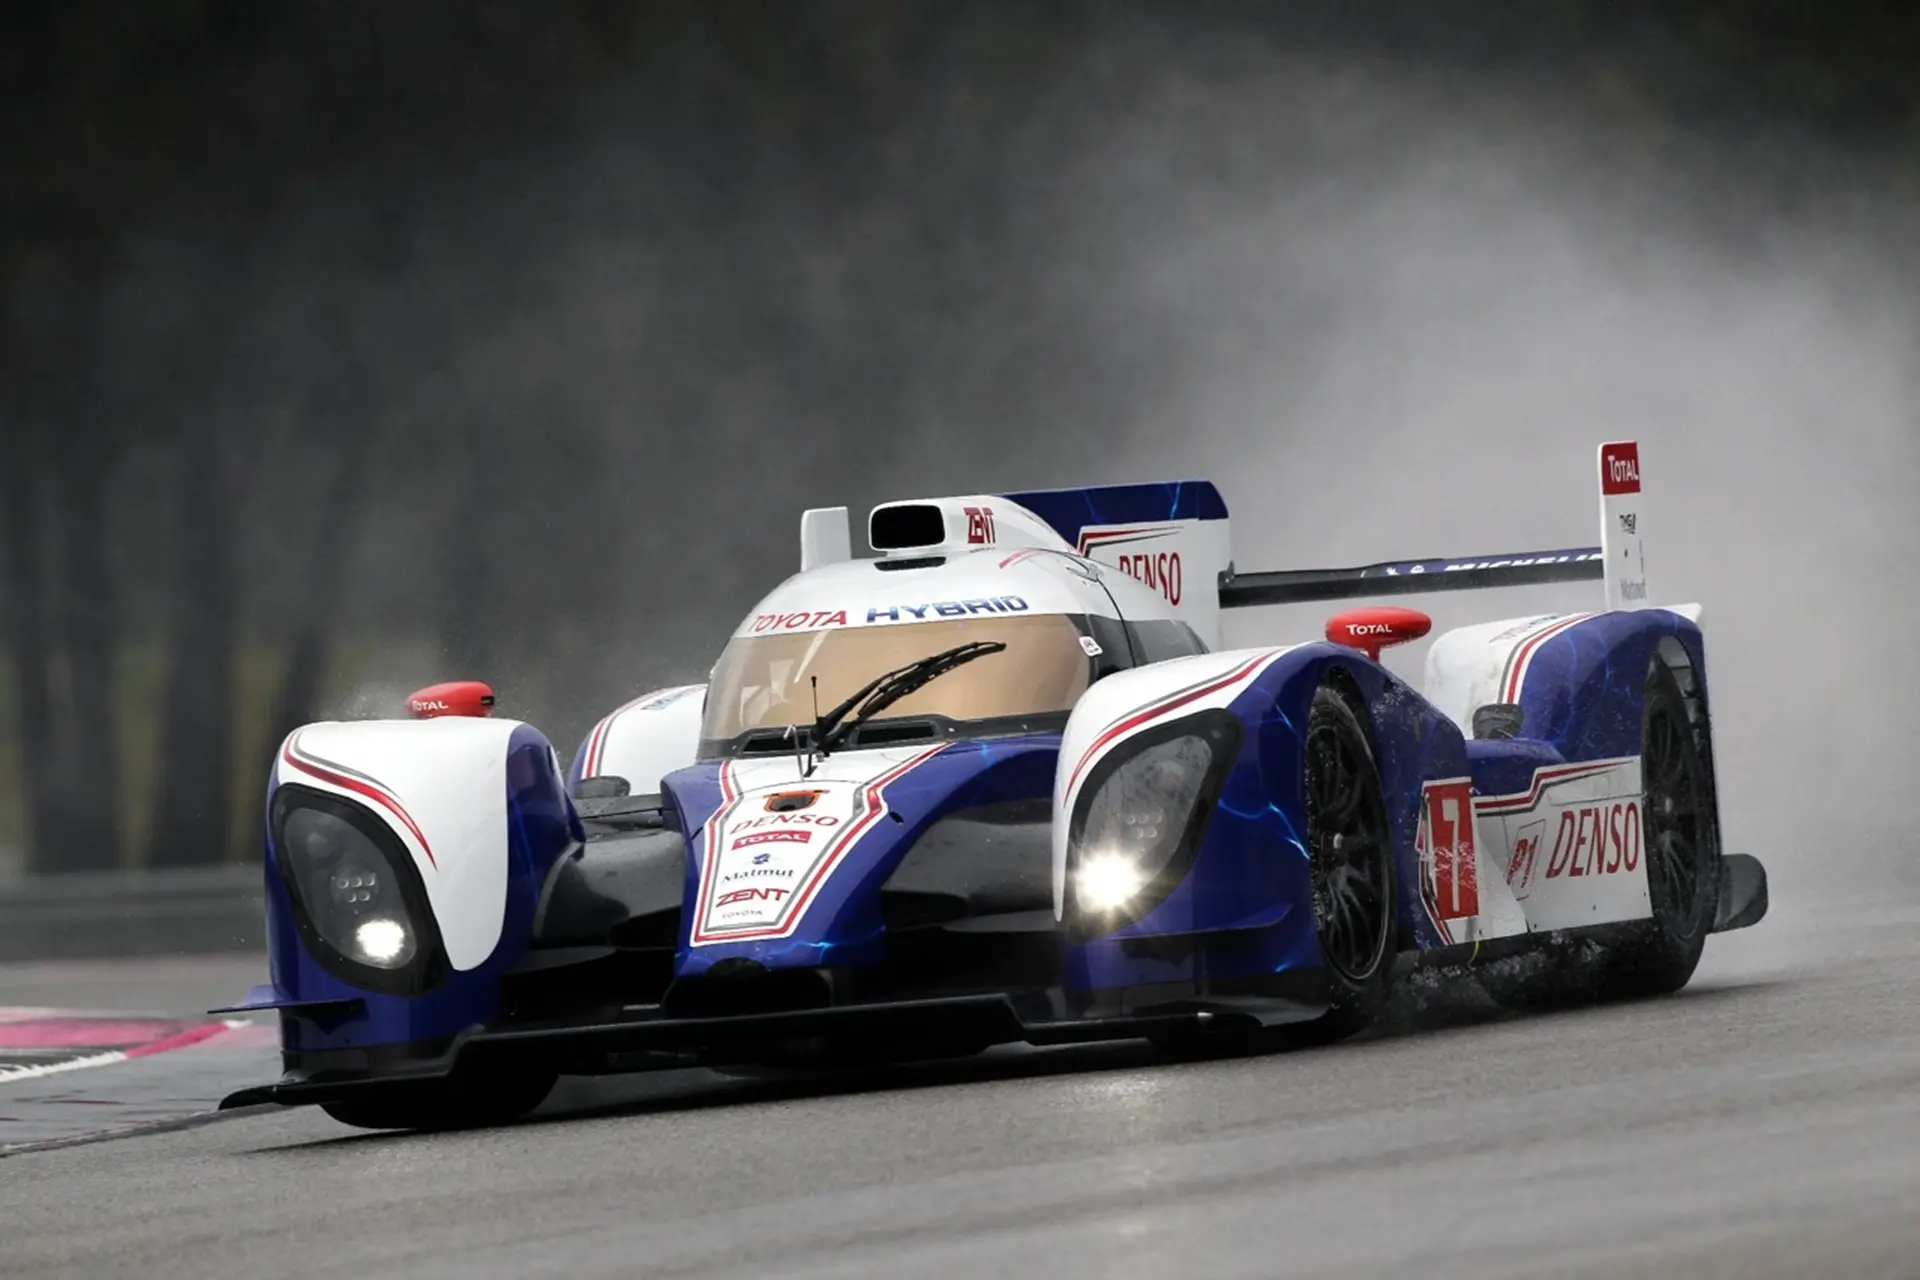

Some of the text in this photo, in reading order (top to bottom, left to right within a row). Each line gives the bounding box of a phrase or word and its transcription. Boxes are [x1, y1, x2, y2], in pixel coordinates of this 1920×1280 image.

[1608, 455, 1639, 482] TOTAL
[963, 507, 996, 544] ZENT
[748, 595, 1029, 632] TOYOTA HYBRID
[1345, 624, 1392, 635] TOTAL
[730, 814, 839, 834] DENSO
[736, 831, 806, 846] TOTAL
[1546, 801, 1639, 878] DENSO
[1442, 798, 1460, 912] 7
[722, 869, 794, 884] Matmut
[716, 888, 790, 908] ZENT
